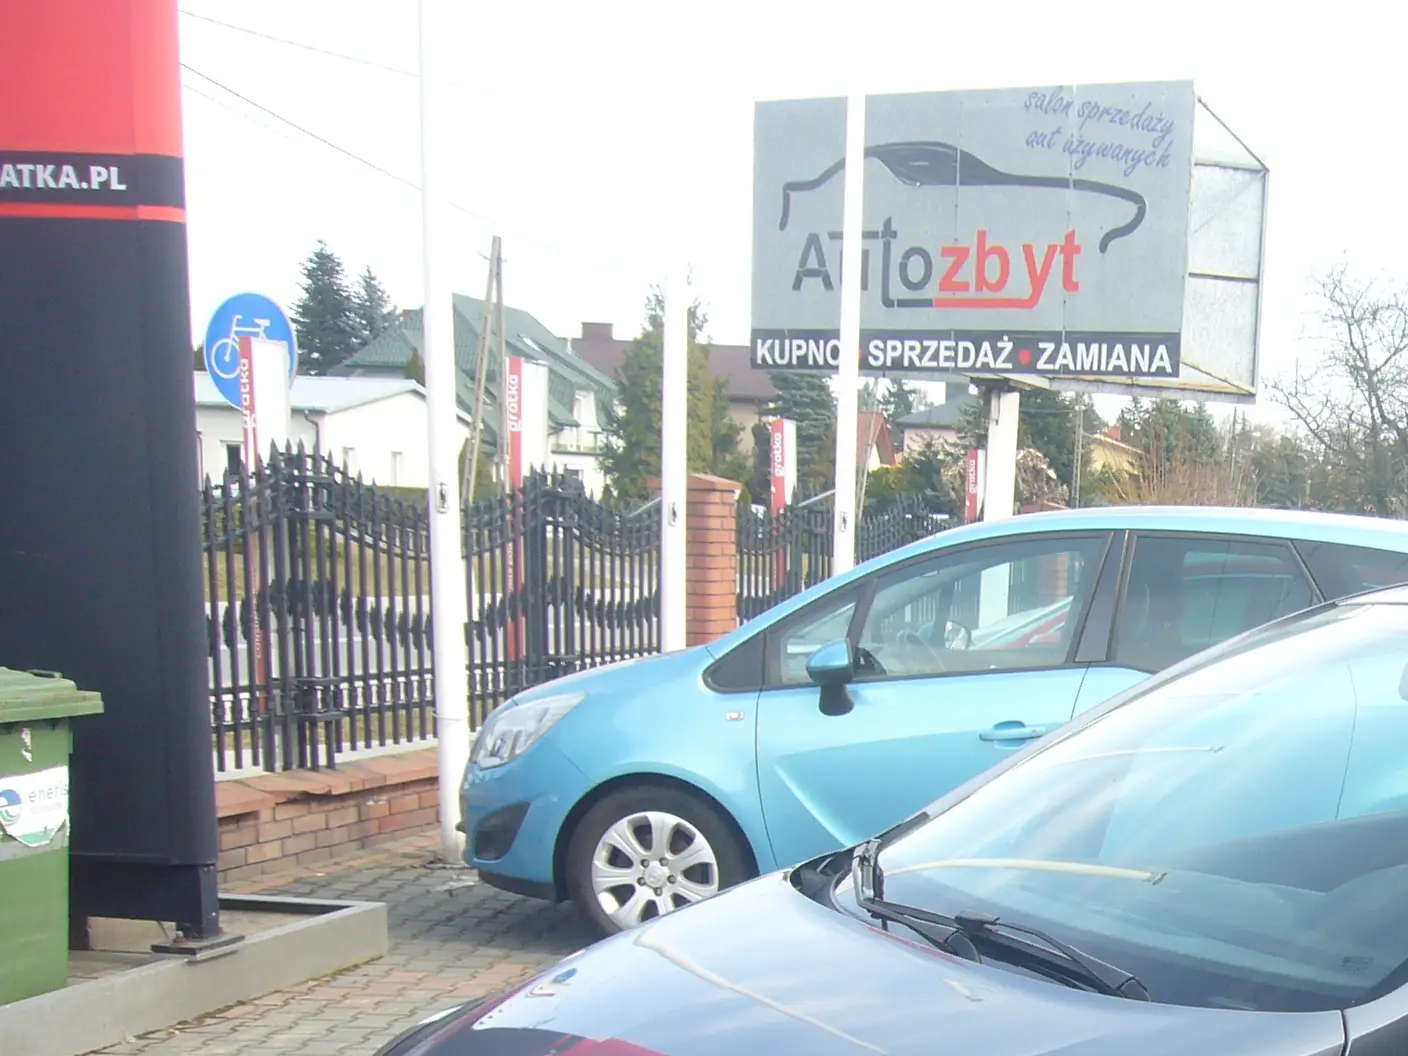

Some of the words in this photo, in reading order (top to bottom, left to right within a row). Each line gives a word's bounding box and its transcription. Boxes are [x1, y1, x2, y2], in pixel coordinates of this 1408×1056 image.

[1024, 85, 1074, 117] salon
[1077, 100, 1175, 148] sprzedaży
[1025, 127, 1063, 150] aut
[1062, 134, 1175, 177] używanych
[867, 335, 1014, 369] SPRZEDAŻ
[1036, 342, 1173, 373] ZAMIANA
[508, 374, 522, 431] gratka
